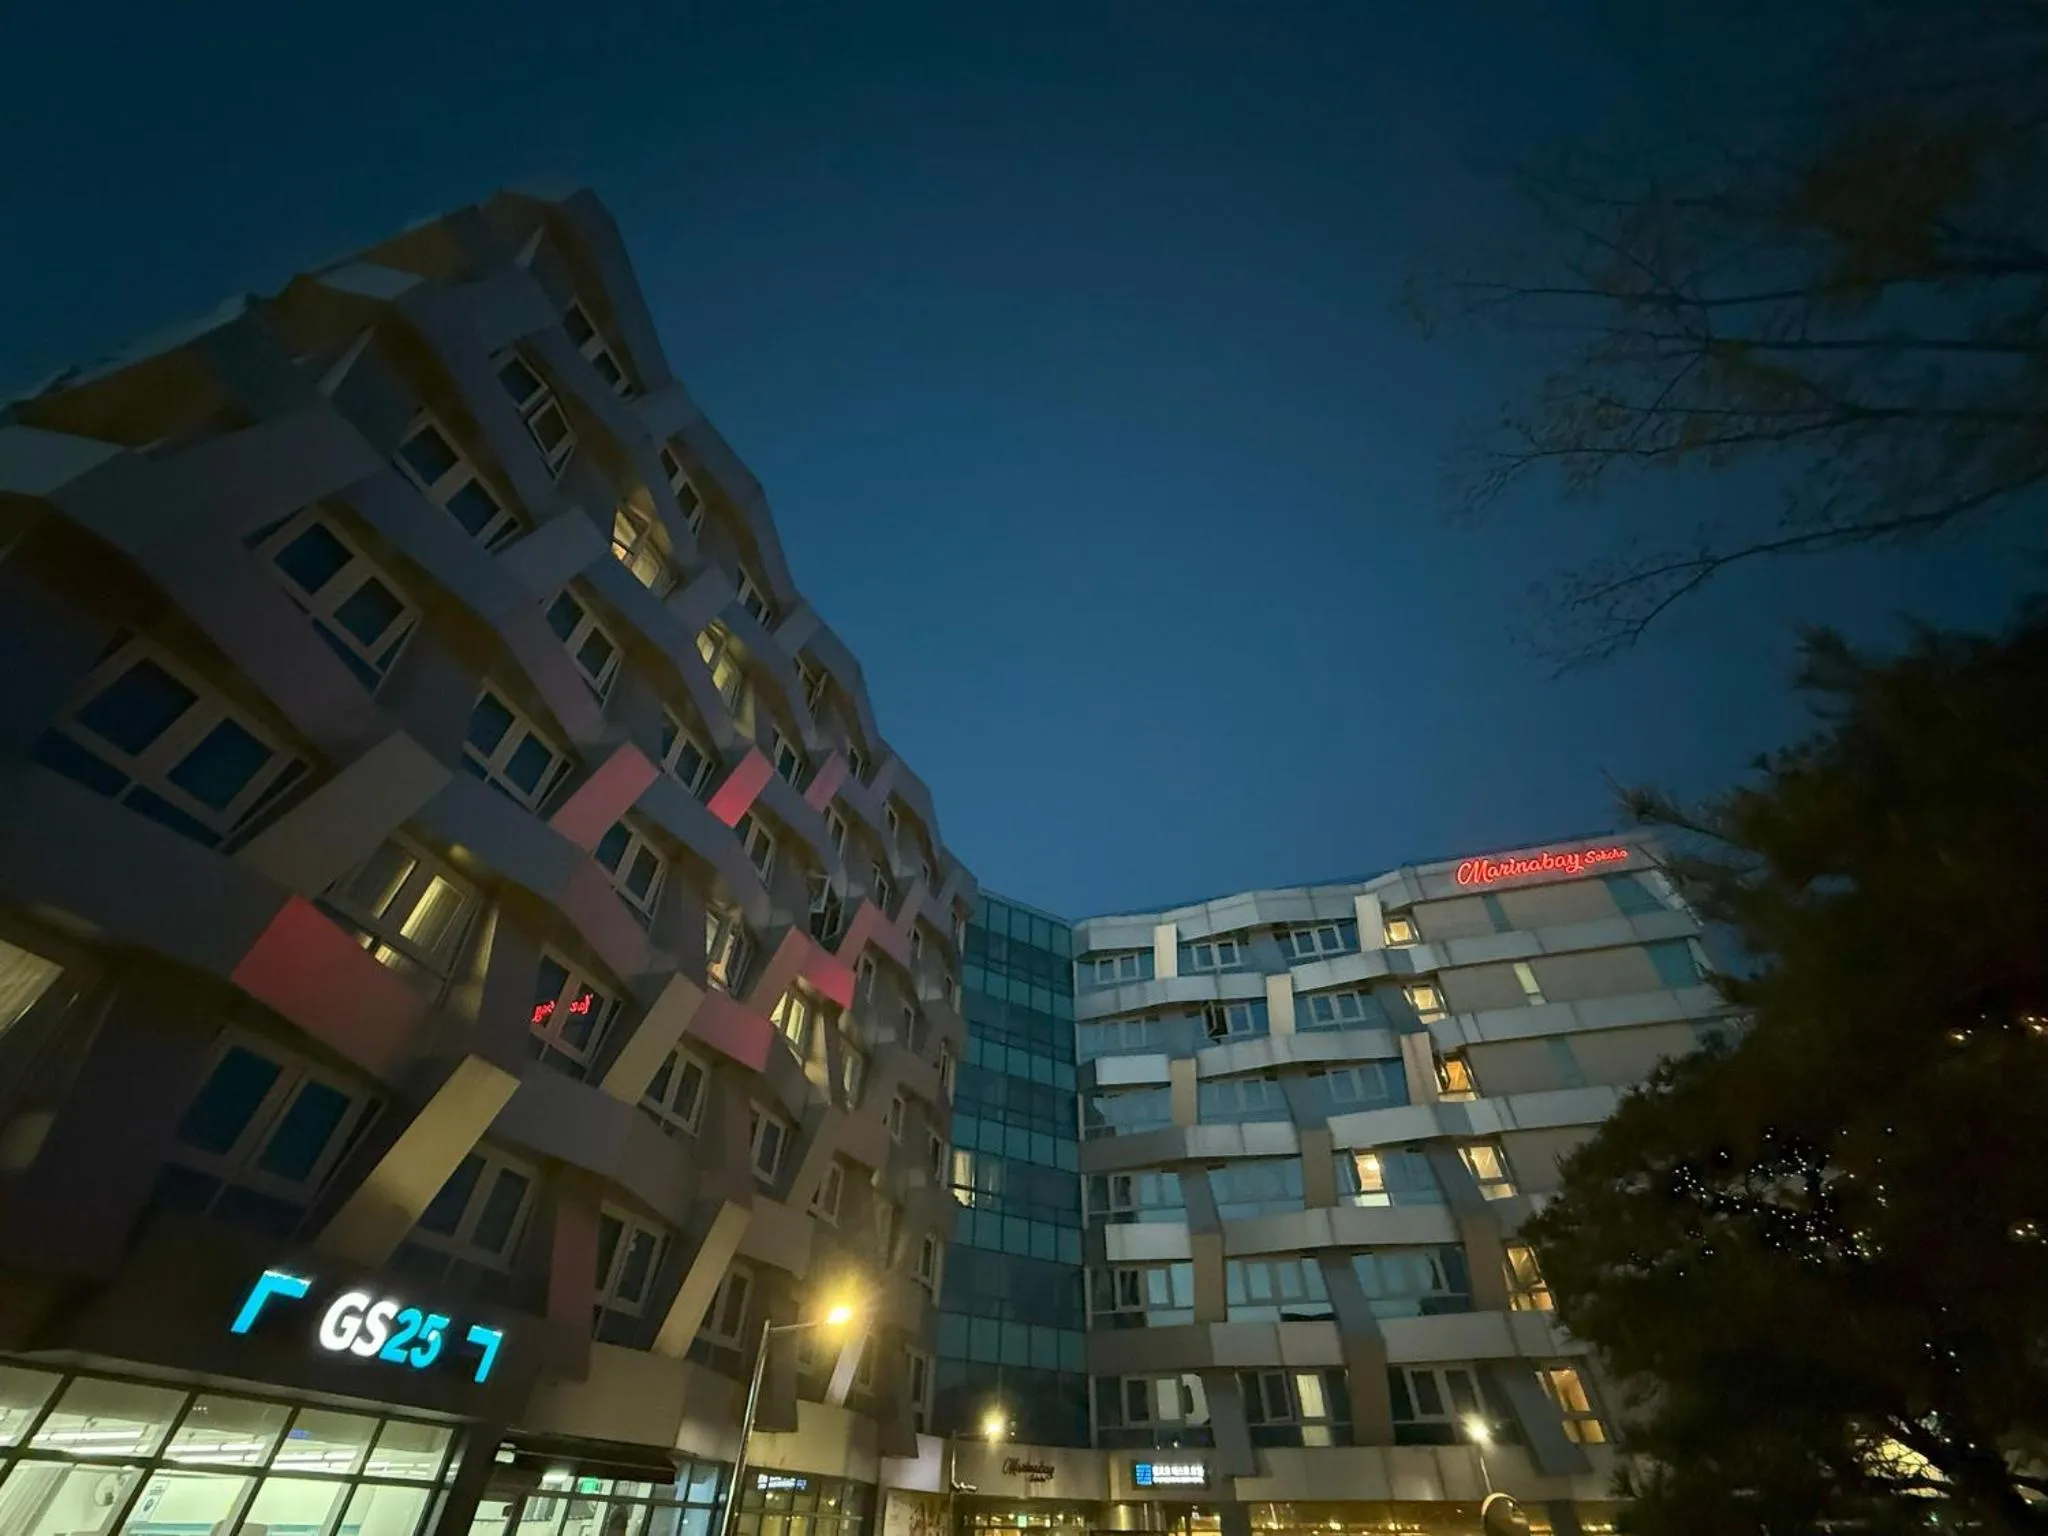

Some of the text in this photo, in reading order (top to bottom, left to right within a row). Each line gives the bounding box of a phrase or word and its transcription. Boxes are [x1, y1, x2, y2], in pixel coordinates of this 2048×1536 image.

[1457, 849, 1629, 884] Marinabay Sokcho
[319, 1292, 450, 1369] GS25
